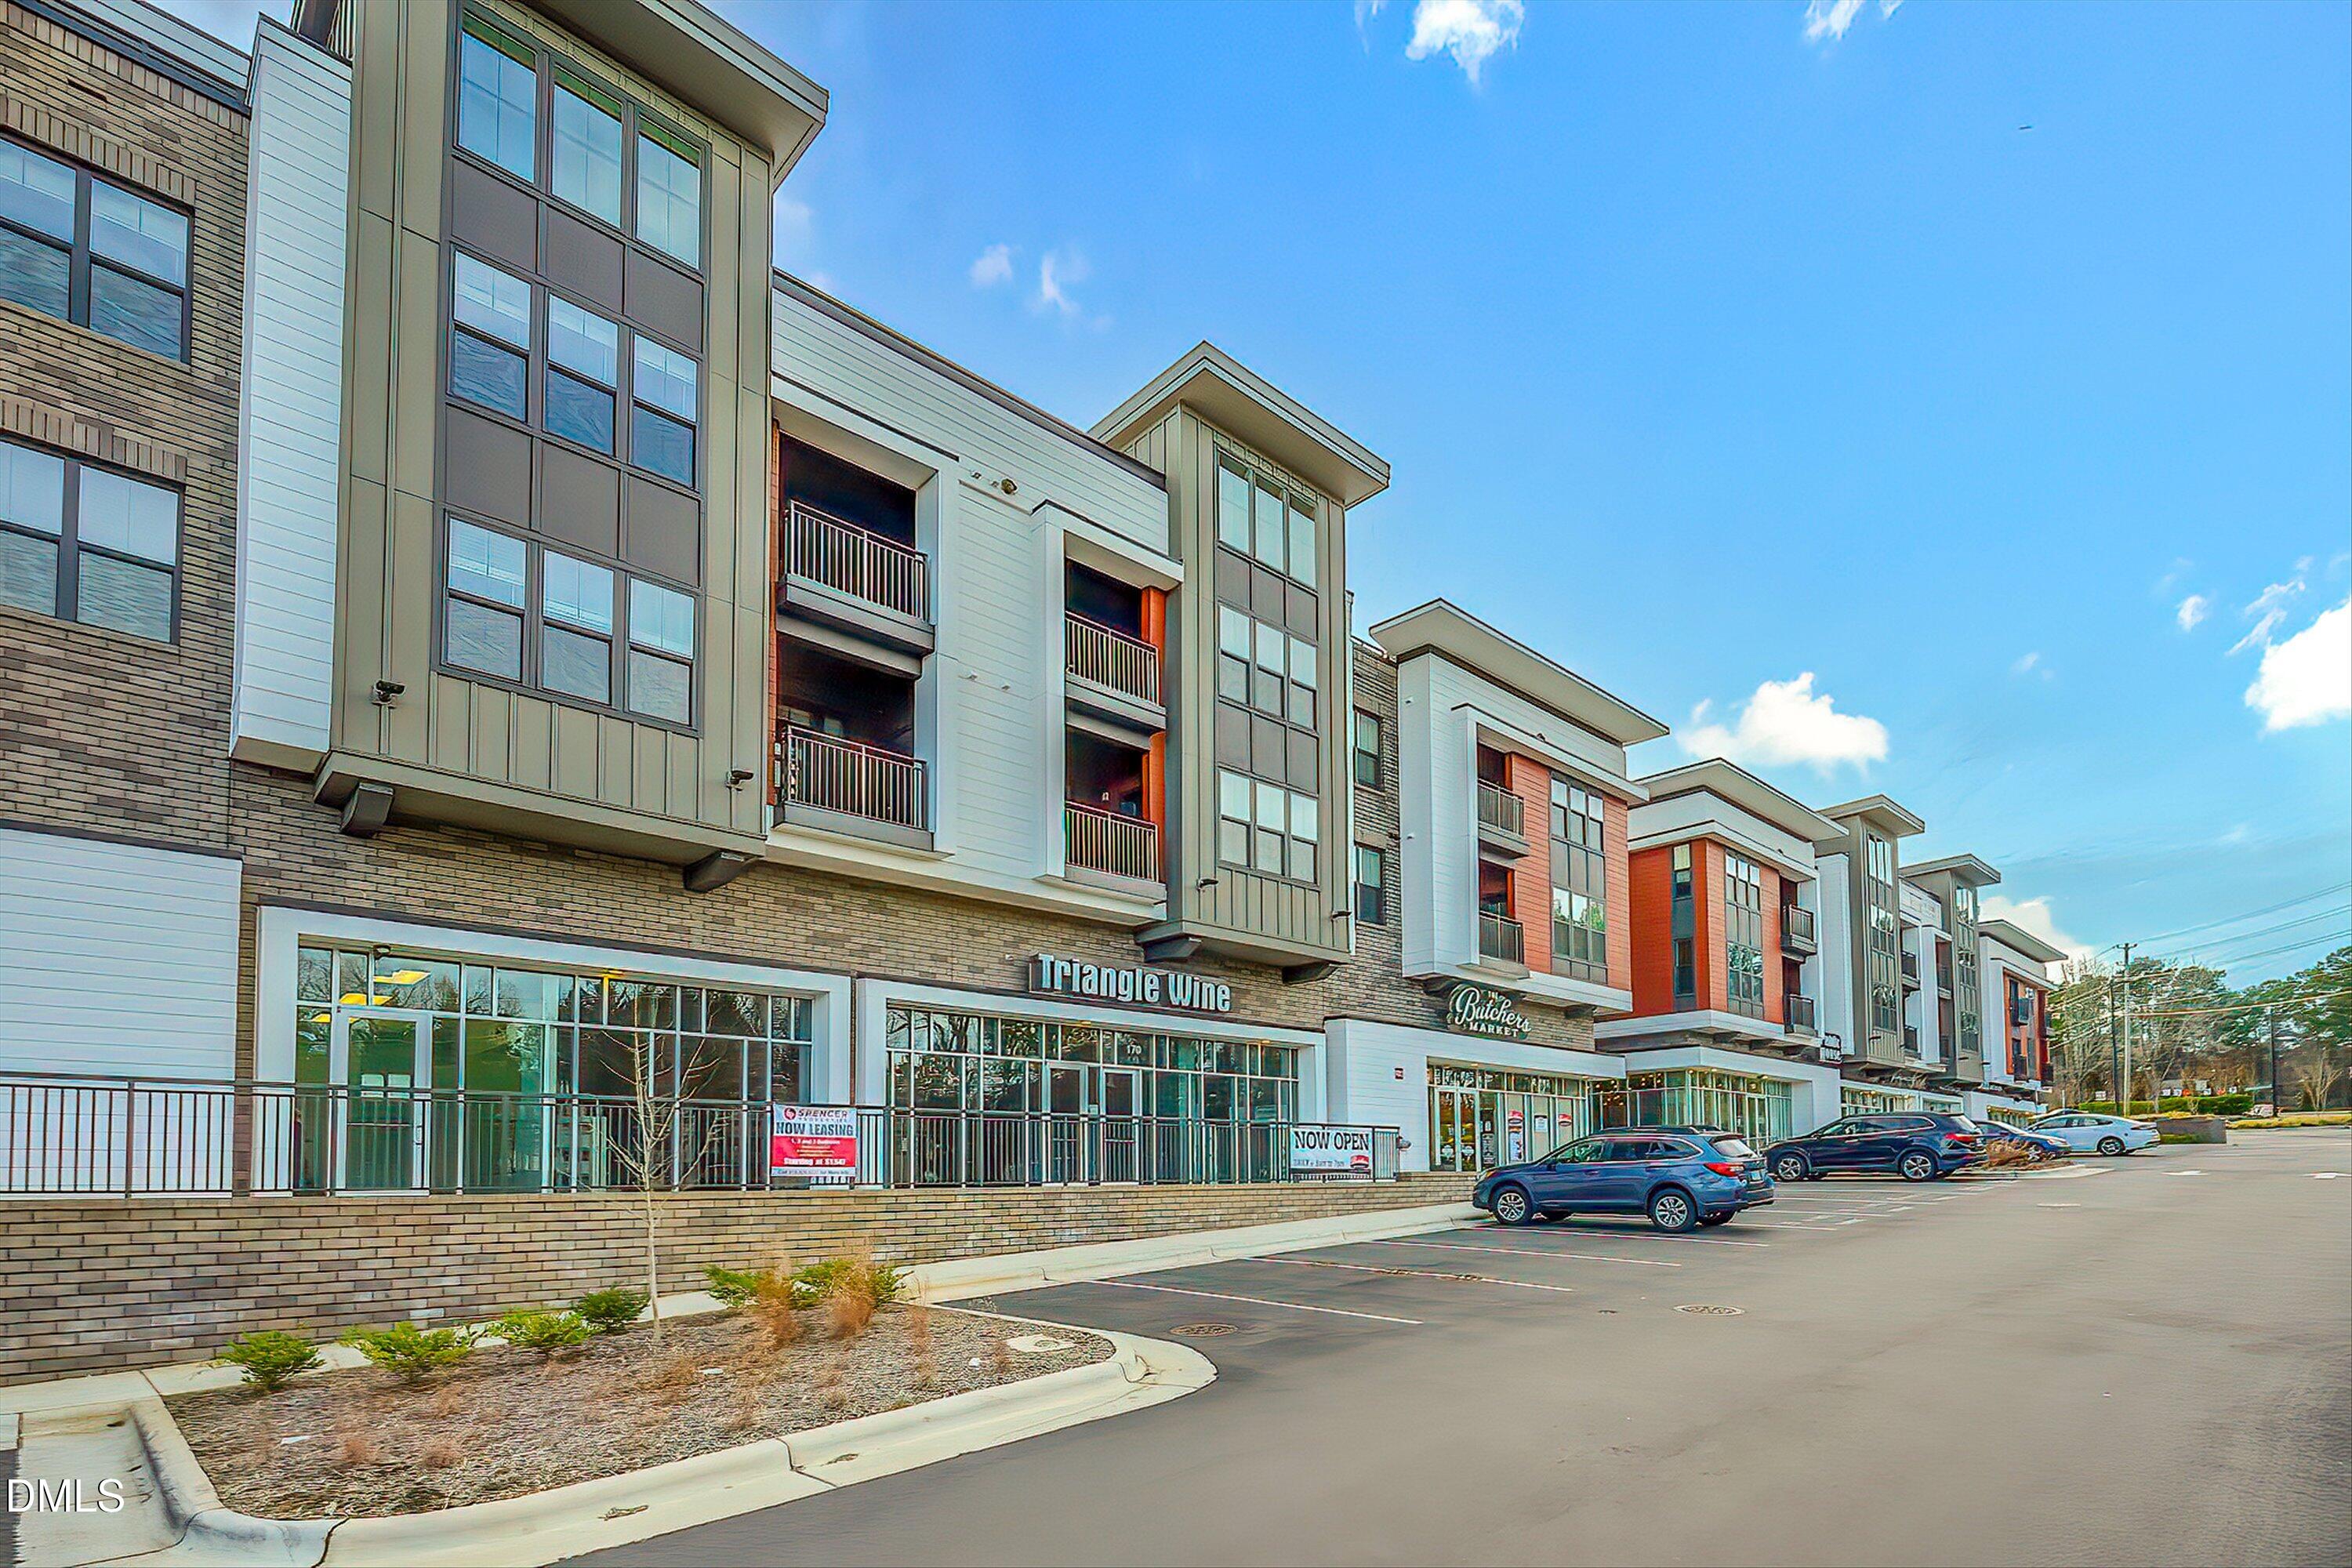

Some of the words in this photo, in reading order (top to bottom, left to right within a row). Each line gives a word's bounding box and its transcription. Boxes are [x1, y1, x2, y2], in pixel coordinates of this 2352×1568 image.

[1038, 953, 1160, 1003] Triangle
[1168, 973, 1231, 1011] Wine
[1469, 1022, 1519, 1038] MARKET
[1127, 1044, 1142, 1054] 170
[798, 1109, 848, 1118] SPENCER
[776, 1122, 805, 1134] NOW
[809, 1123, 853, 1136] LEASING
[1294, 1131, 1330, 1149] NOW
[1334, 1132, 1369, 1150] OPEN
